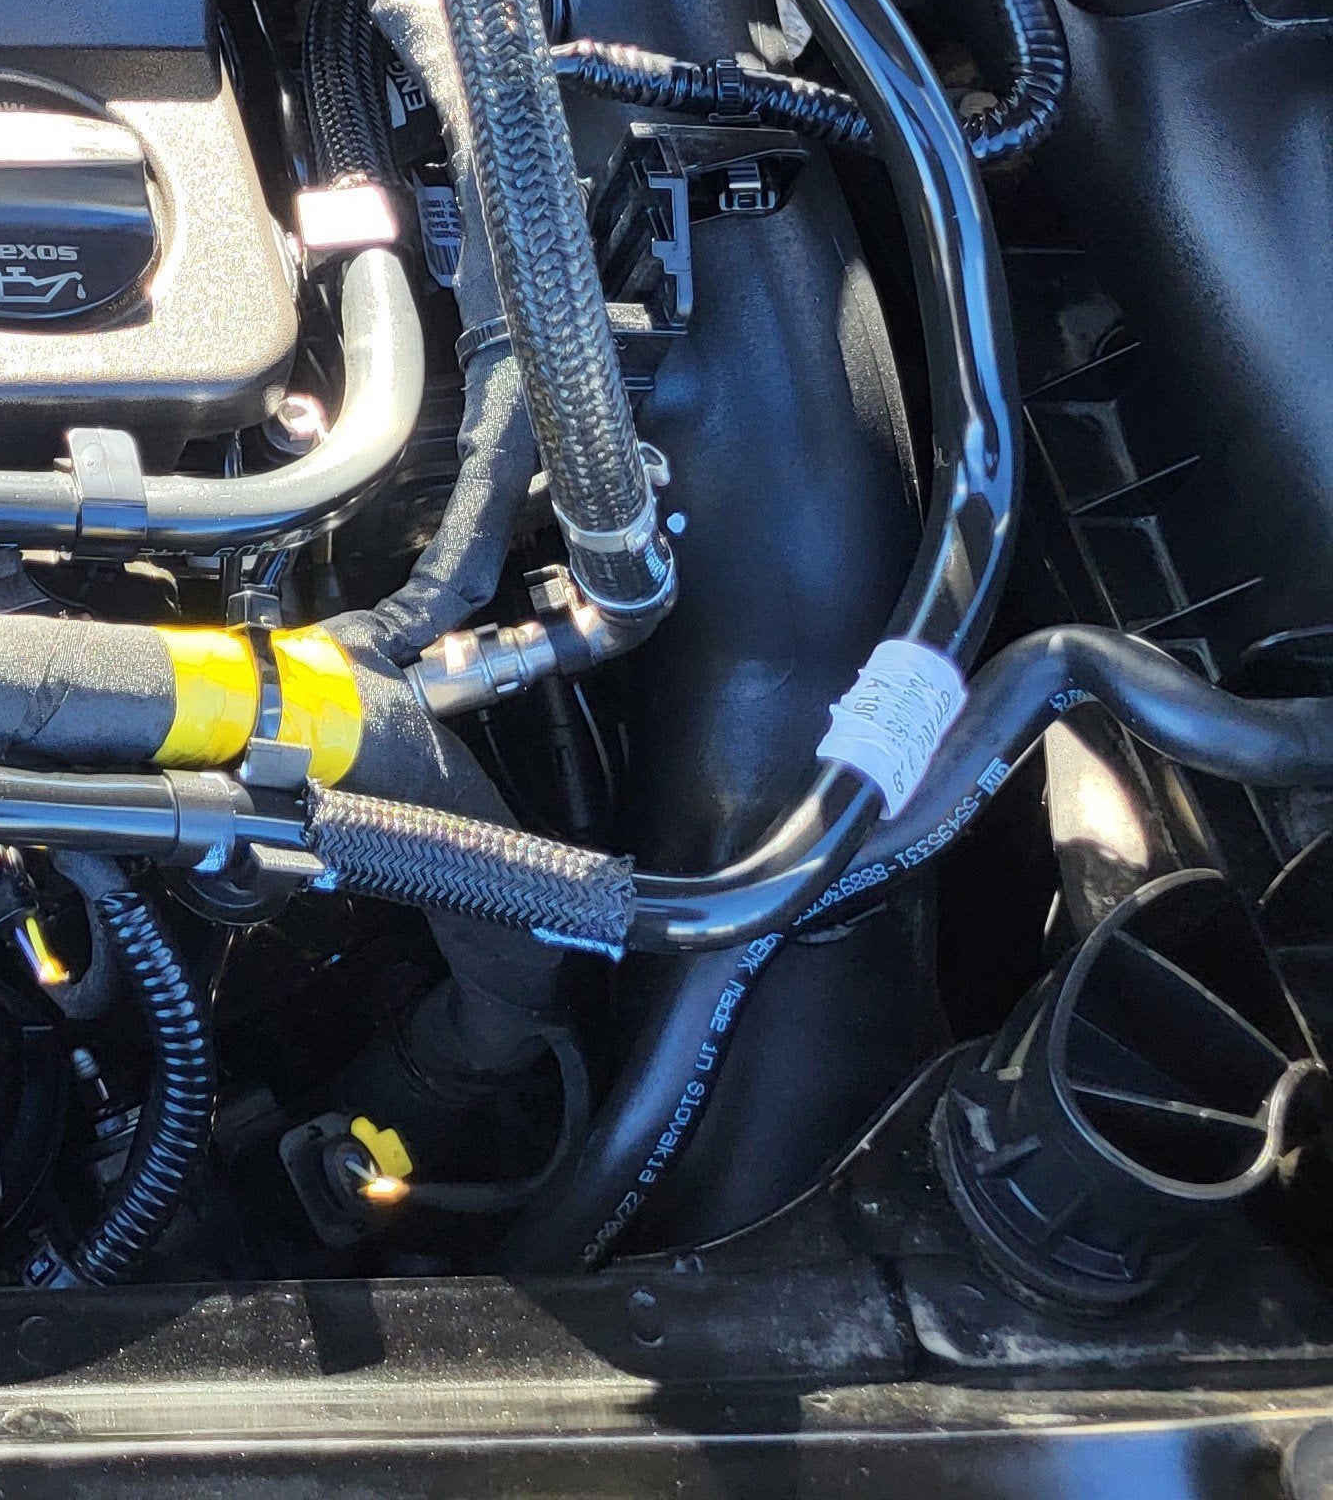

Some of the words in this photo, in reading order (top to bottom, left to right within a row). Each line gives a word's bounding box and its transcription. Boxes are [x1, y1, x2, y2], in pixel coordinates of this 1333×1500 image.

[709, 979, 746, 1033] Made
[694, 1041, 719, 1071] in
[637, 1079, 706, 1184] Slovakia
